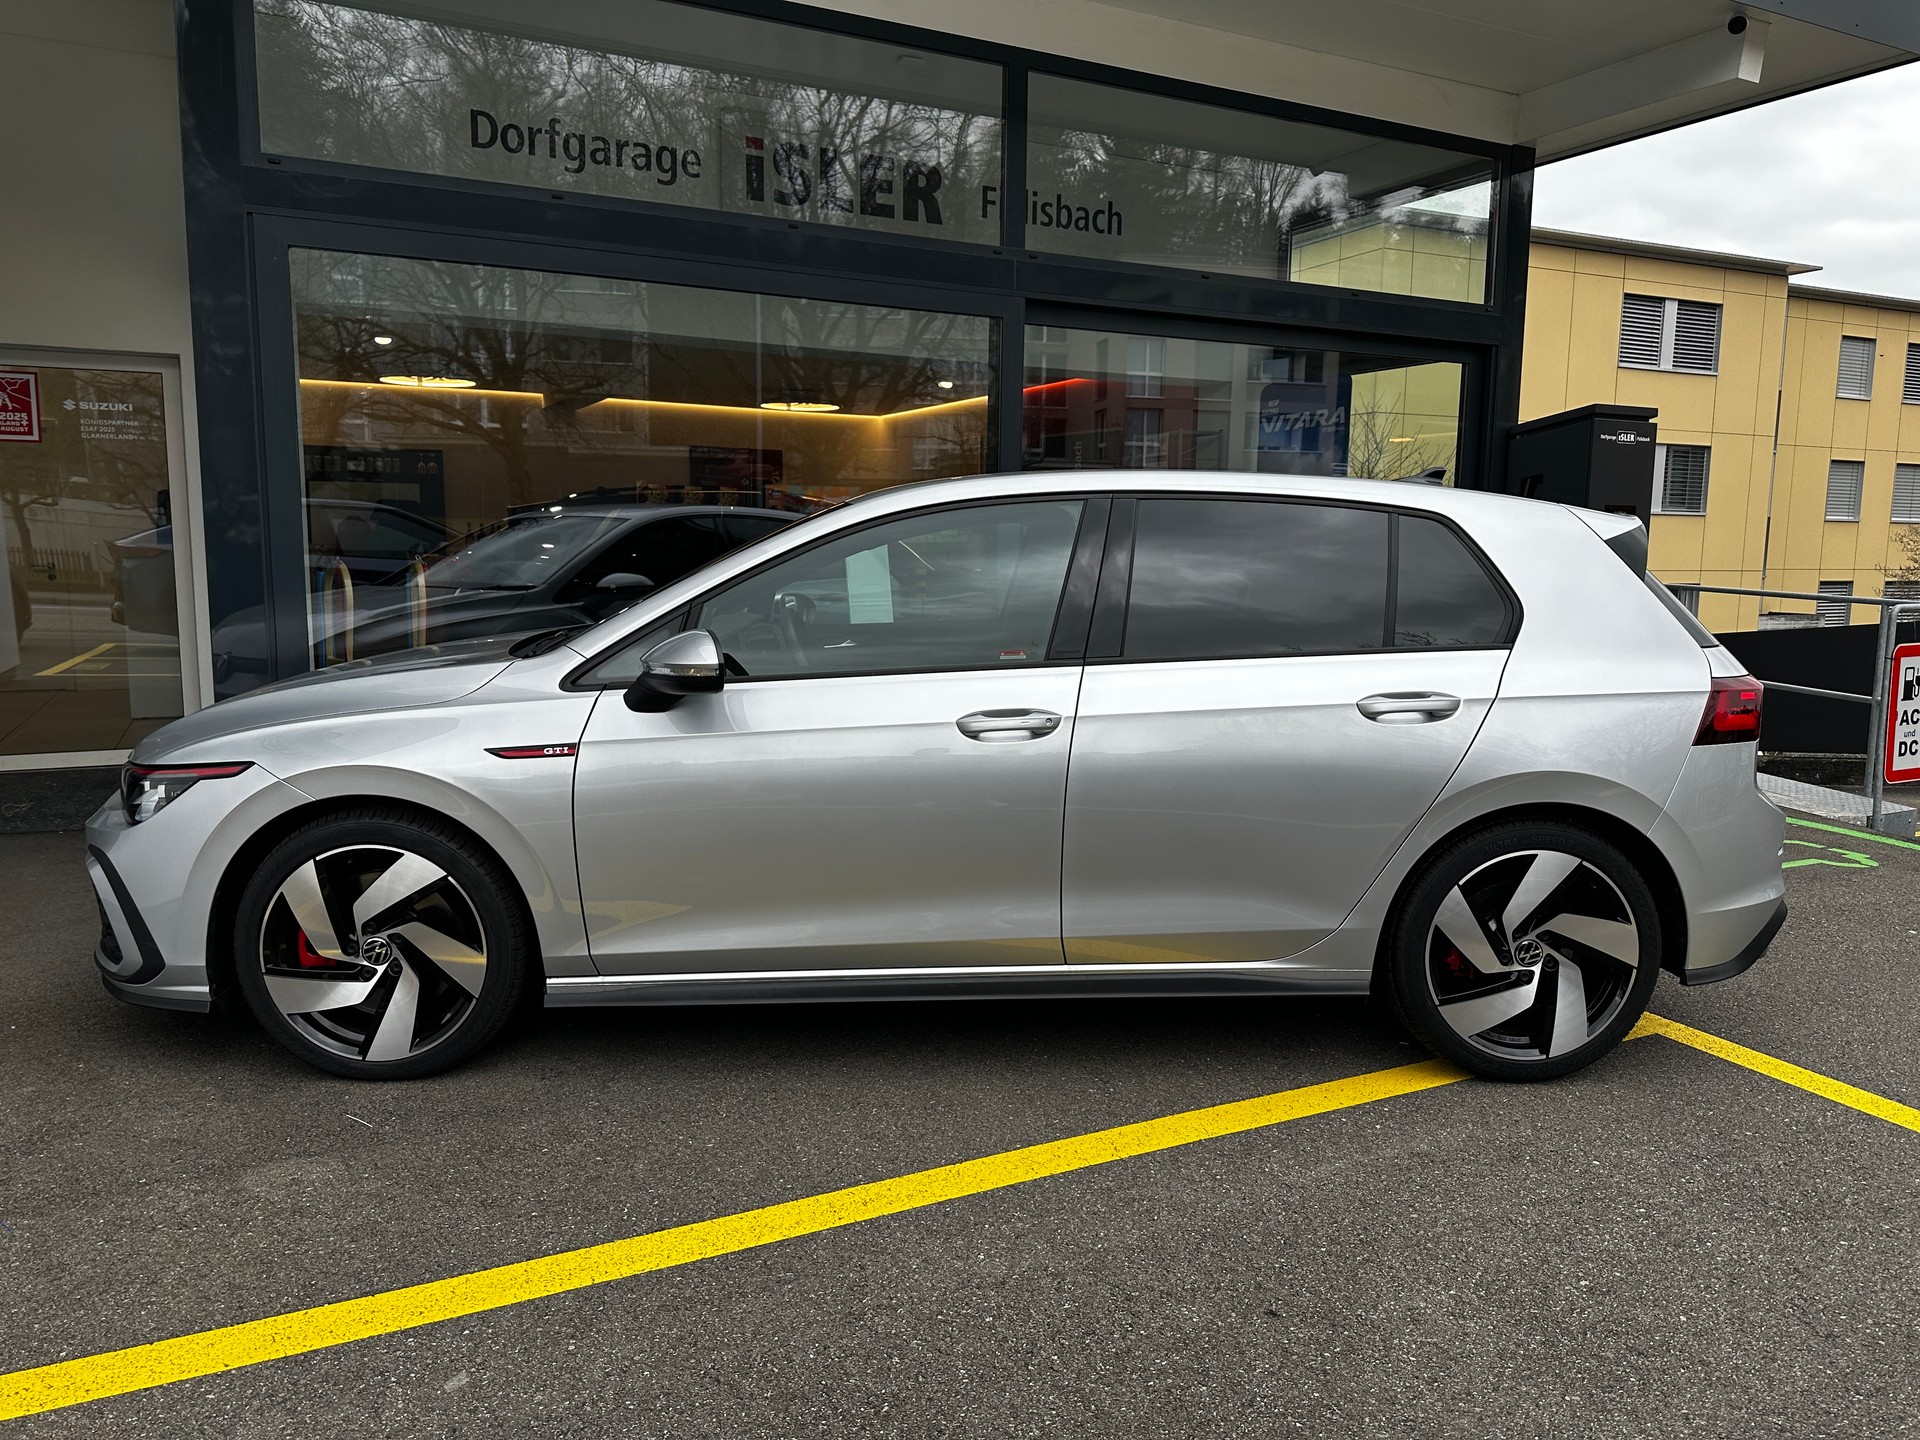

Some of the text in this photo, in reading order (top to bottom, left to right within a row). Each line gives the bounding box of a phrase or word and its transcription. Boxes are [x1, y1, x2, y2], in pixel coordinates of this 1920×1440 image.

[470, 109, 701, 186] Dorfgarage
[982, 185, 1123, 236] Fisbach
[79, 401, 133, 412] SUZUKI
[0, 412, 28, 421] 2025
[1261, 406, 1345, 433] VITARA
[1899, 708, 1920, 726] AC
[1904, 729, 1916, 738] und
[543, 746, 569, 755] GTI
[1898, 739, 1919, 757] DC
